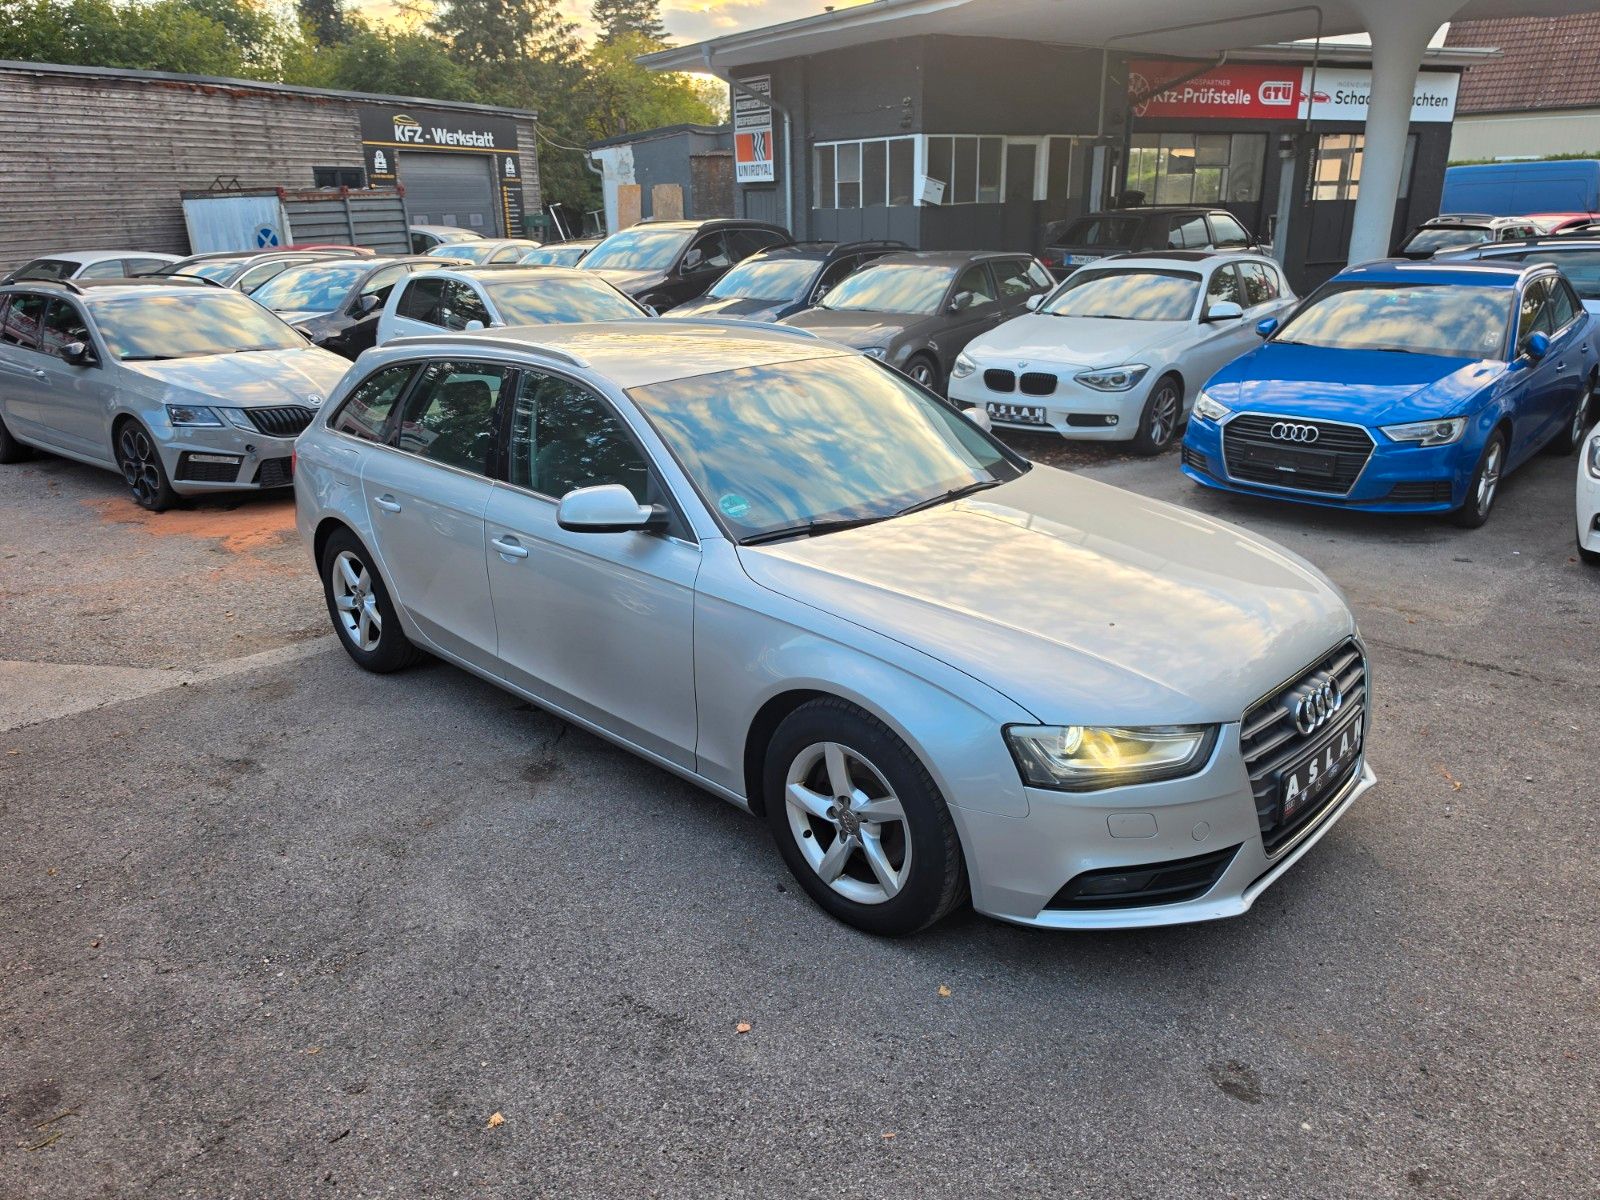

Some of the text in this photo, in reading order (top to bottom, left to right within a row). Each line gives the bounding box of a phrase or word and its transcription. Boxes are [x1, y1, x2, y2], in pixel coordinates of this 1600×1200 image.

[394, 125, 424, 143] KFZ
[431, 128, 494, 147] Werkstatt
[738, 163, 772, 177] UNIROYAL
